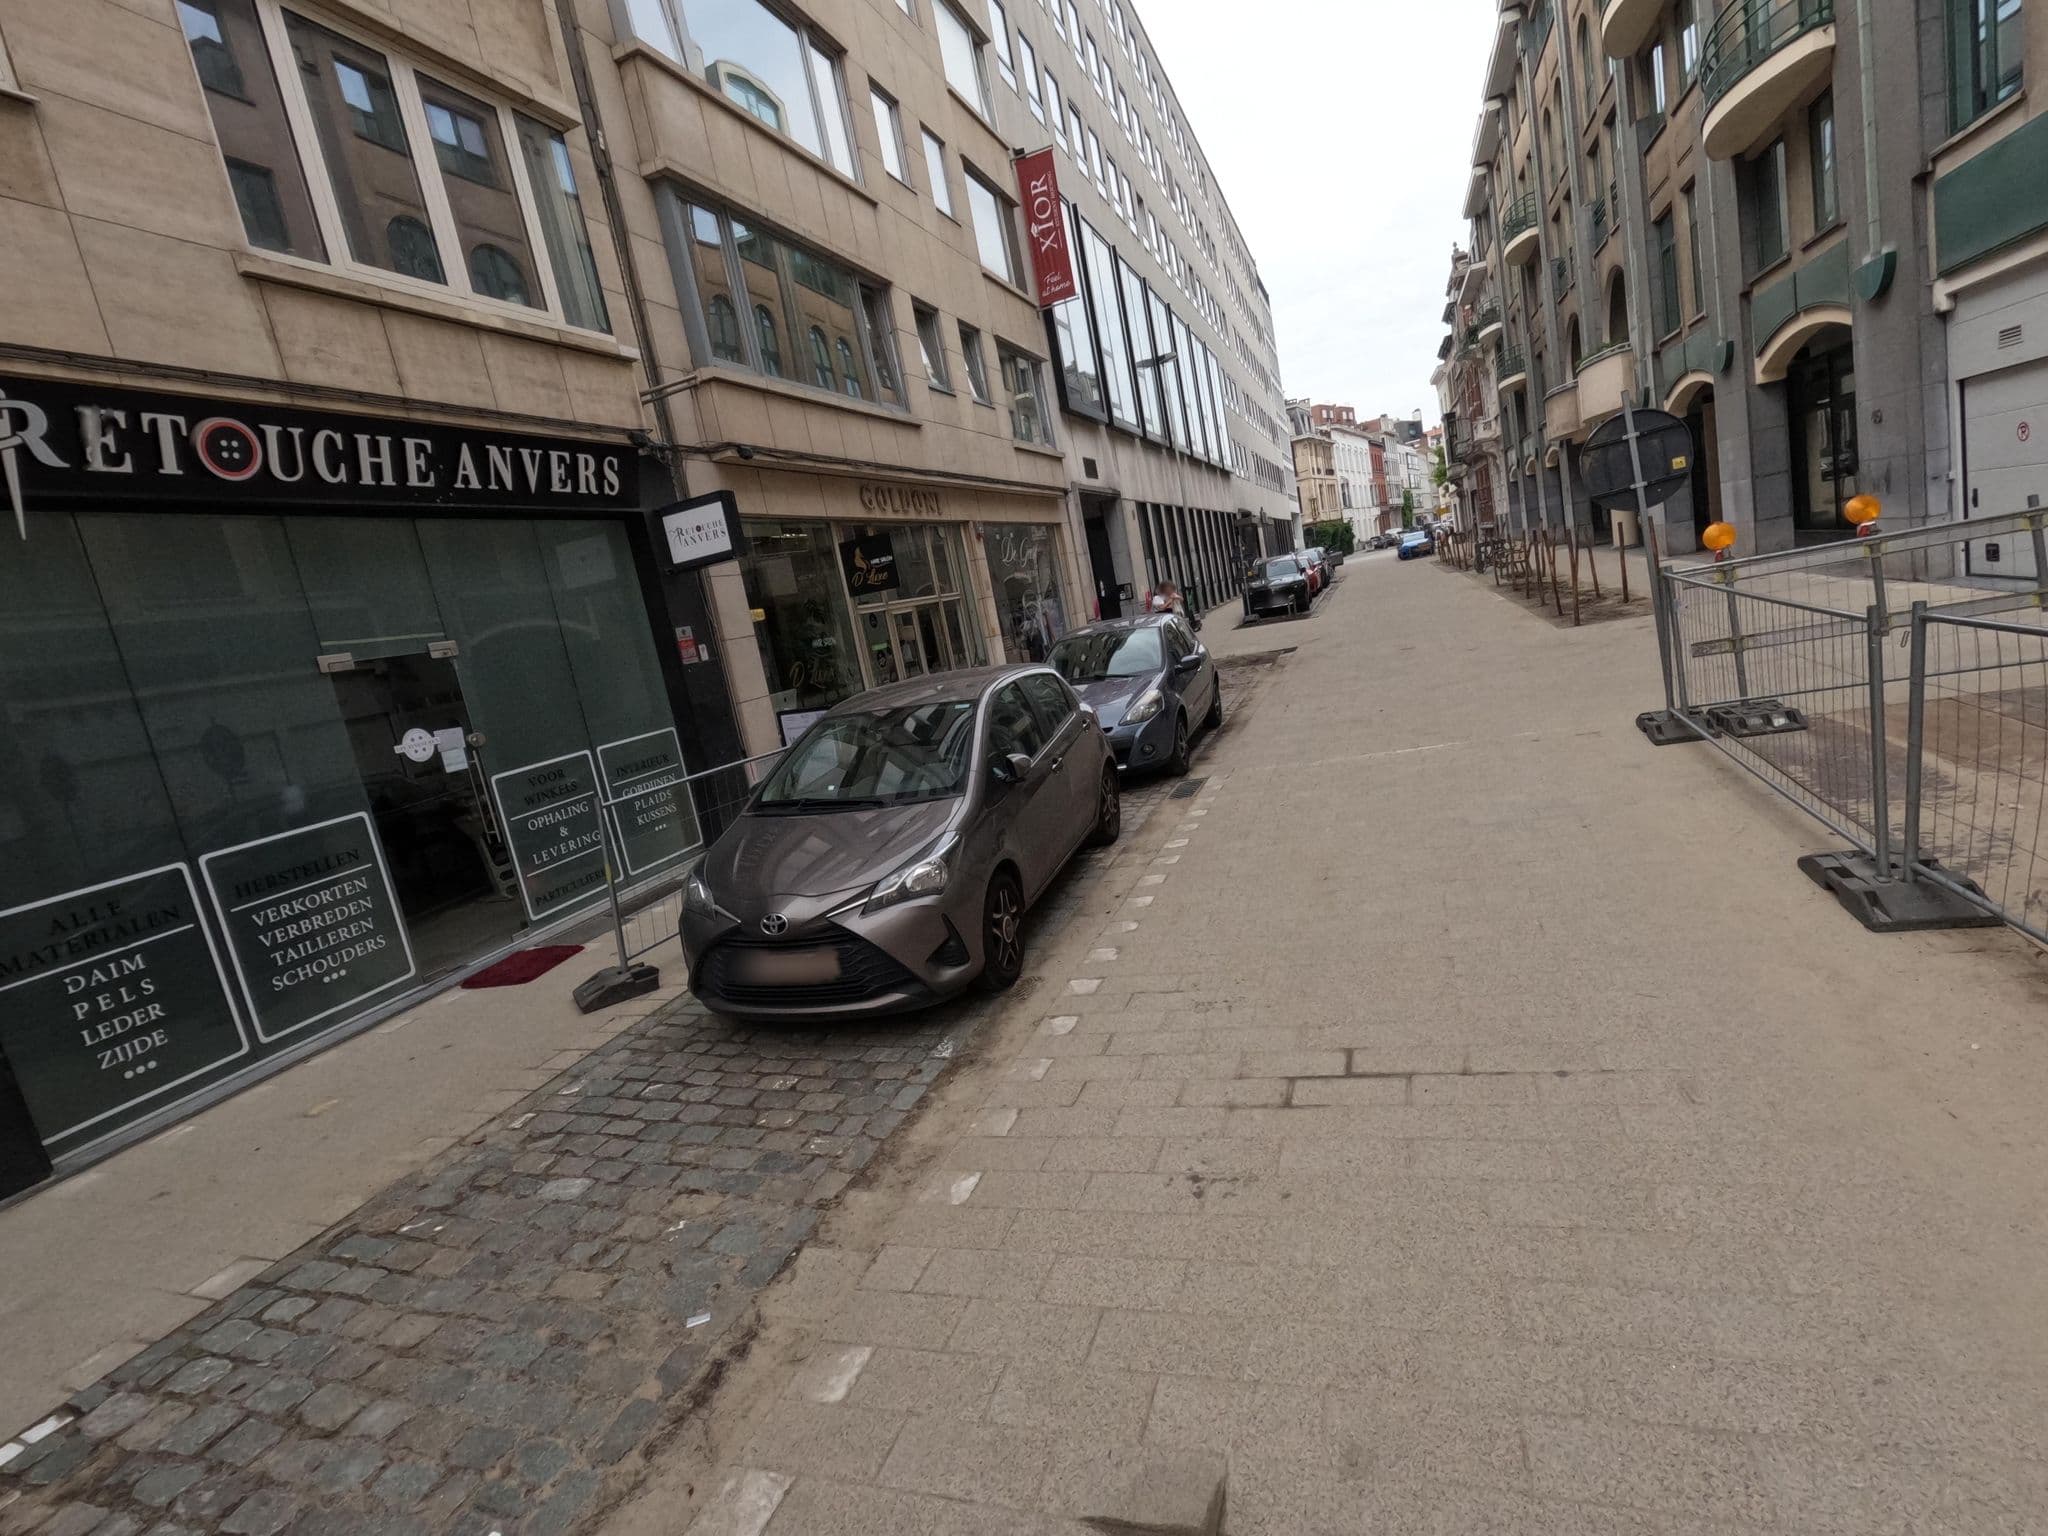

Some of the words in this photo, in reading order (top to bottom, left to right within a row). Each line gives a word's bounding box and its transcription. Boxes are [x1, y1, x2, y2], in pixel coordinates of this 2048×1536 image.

[1030, 173, 1058, 254] XIOR
[0, 388, 436, 490] RETOUCHE
[453, 442, 621, 496] ANVERS
[683, 529, 727, 548] ANVERS
[528, 768, 566, 789] VOOR
[527, 801, 590, 831] OPHALING
[634, 789, 674, 811] PLAIDS
[637, 803, 678, 826] KUSSENS
[532, 830, 601, 865] LEVERING
[559, 826, 569, 838] &
[235, 848, 361, 899] HERSTELLEN
[48, 898, 124, 937] ALLE
[251, 877, 369, 928] VERKORTEN
[258, 896, 374, 949] VERBREDEN
[270, 917, 375, 968] TAILLEREN
[271, 933, 387, 992] SCHOUDERS
[62, 953, 148, 995] DAIM
[72, 978, 156, 1021] PELS
[80, 1002, 167, 1047] LEDER
[97, 1029, 169, 1070] ZIJDE
